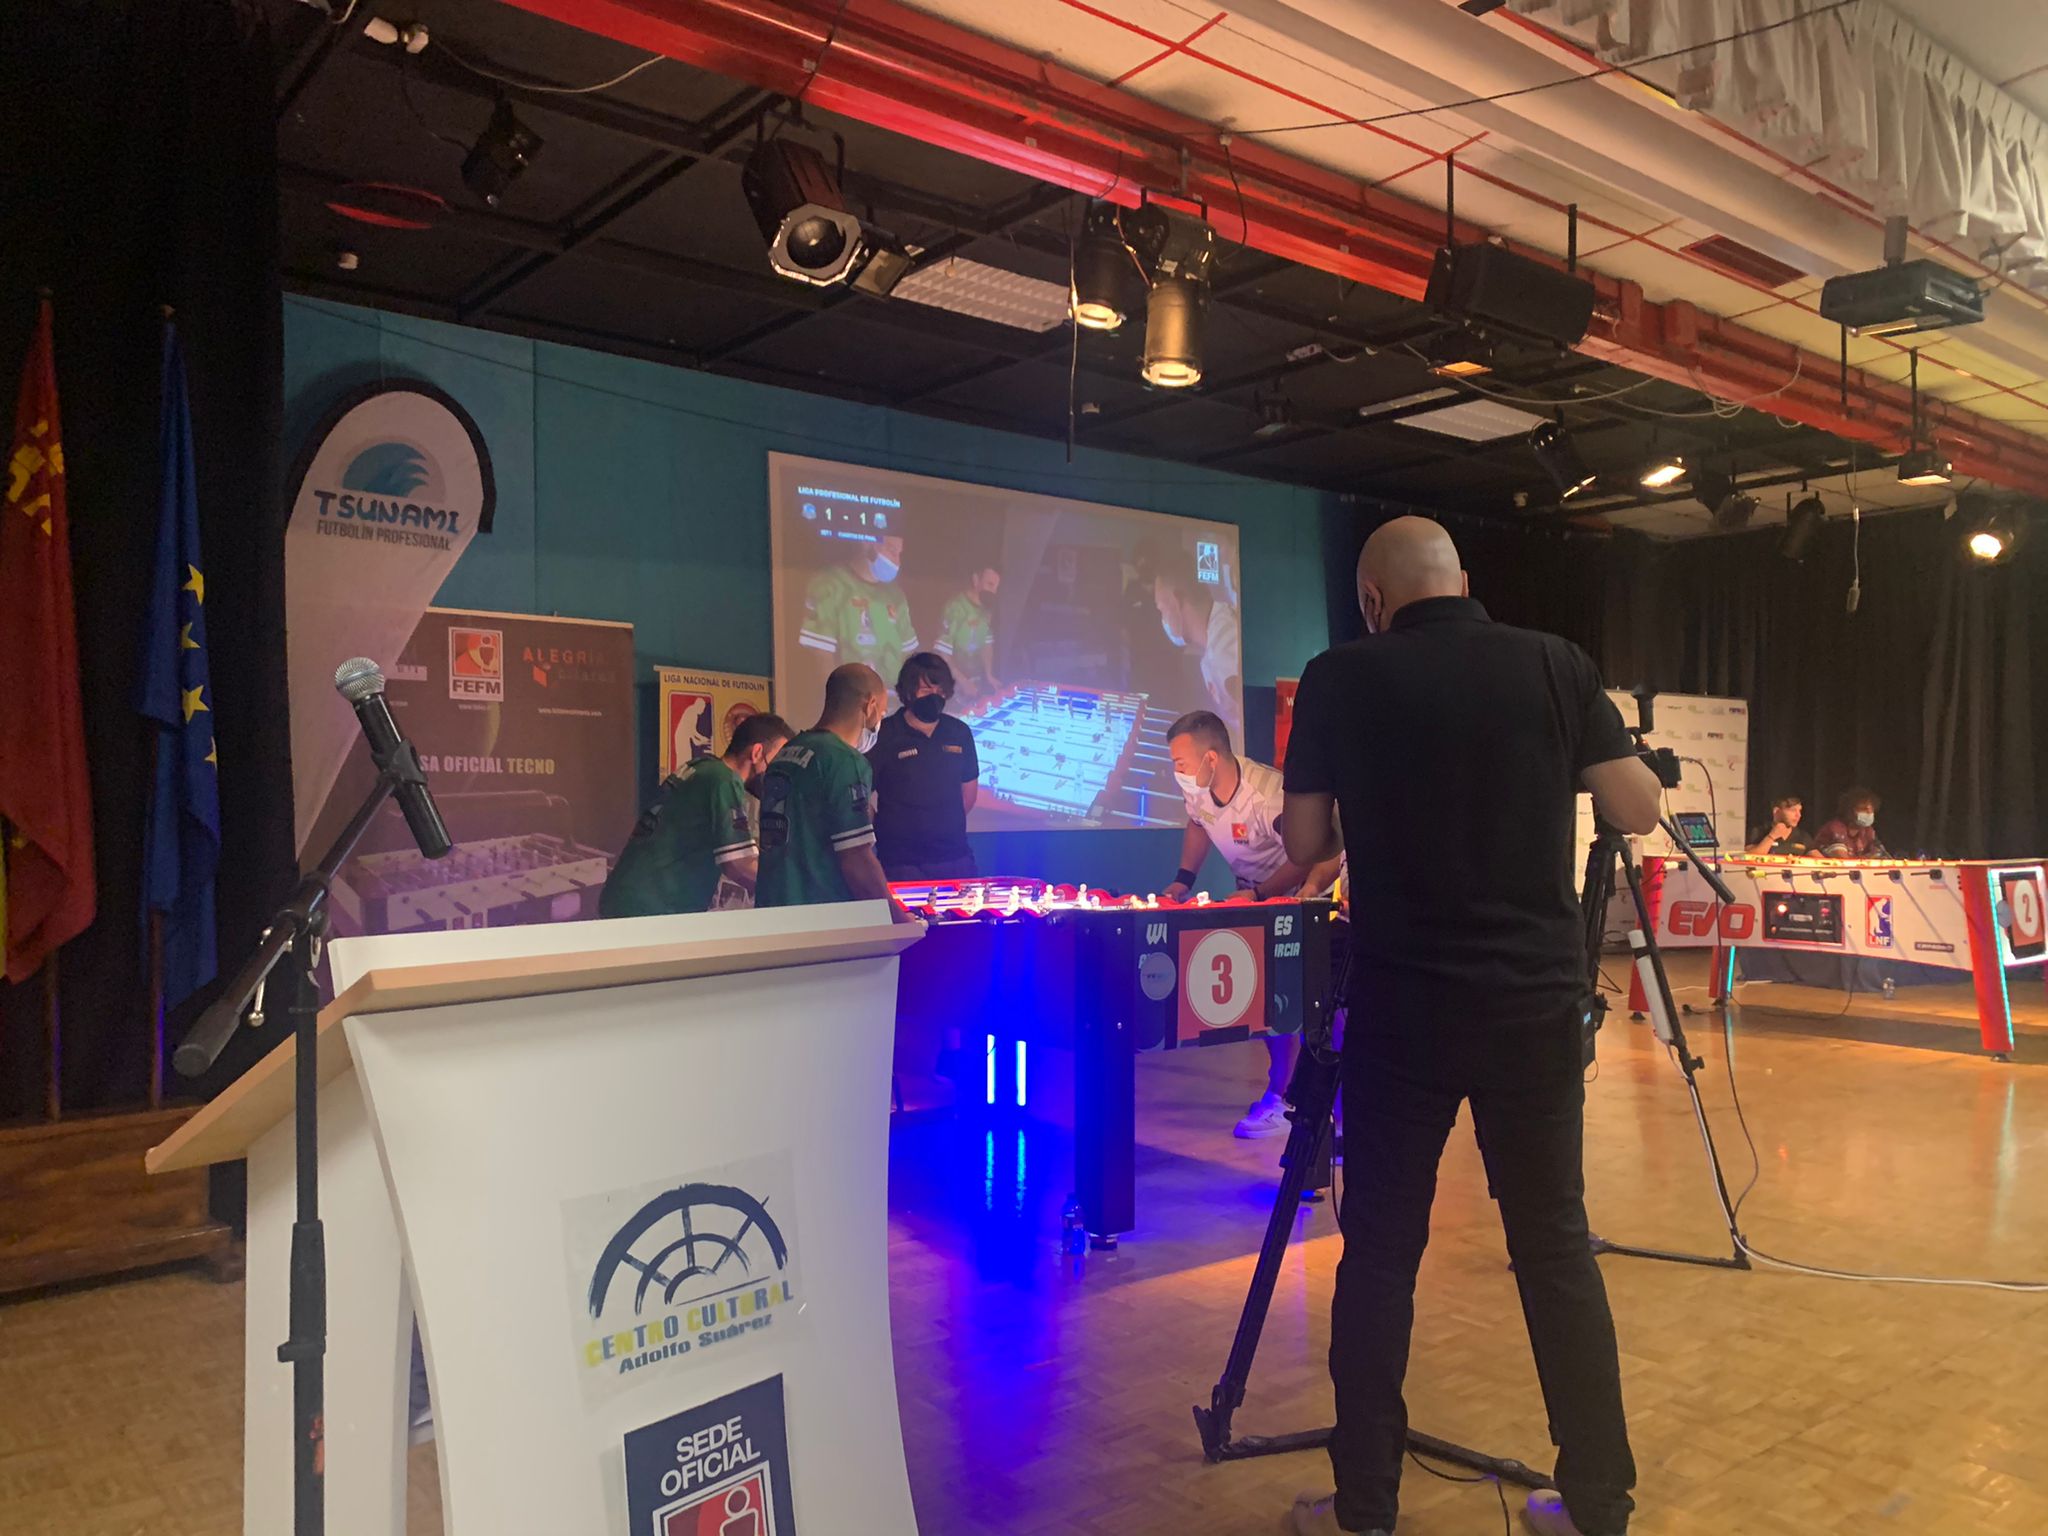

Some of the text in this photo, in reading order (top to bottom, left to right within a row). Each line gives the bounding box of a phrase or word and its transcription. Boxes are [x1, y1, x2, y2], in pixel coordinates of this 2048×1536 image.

[798, 486, 814, 496] LIGA
[814, 488, 860, 503] PROFESIONAL
[314, 490, 460, 534] TSUNAMI
[825, 508, 832, 521] 1
[860, 513, 866, 525] 1
[375, 527, 452, 550] PROFESIONAL
[452, 678, 501, 695] FEFM
[664, 674, 681, 684] LIGA
[683, 676, 719, 688] NACIONAL
[721, 680, 731, 688] DE
[443, 757, 503, 774] OFICIAL
[506, 757, 555, 774] TECNO
[1668, 900, 1756, 939] EVO
[2022, 893, 2032, 923] 2
[1869, 936, 1891, 947] LNF
[1211, 954, 1234, 1005] 3
[584, 1280, 795, 1369] CENTRO CULTURAL
[619, 1313, 773, 1375] Adolfo Suárez
[676, 1415, 744, 1463] SEDE
[660, 1437, 761, 1497] OFICIAL
